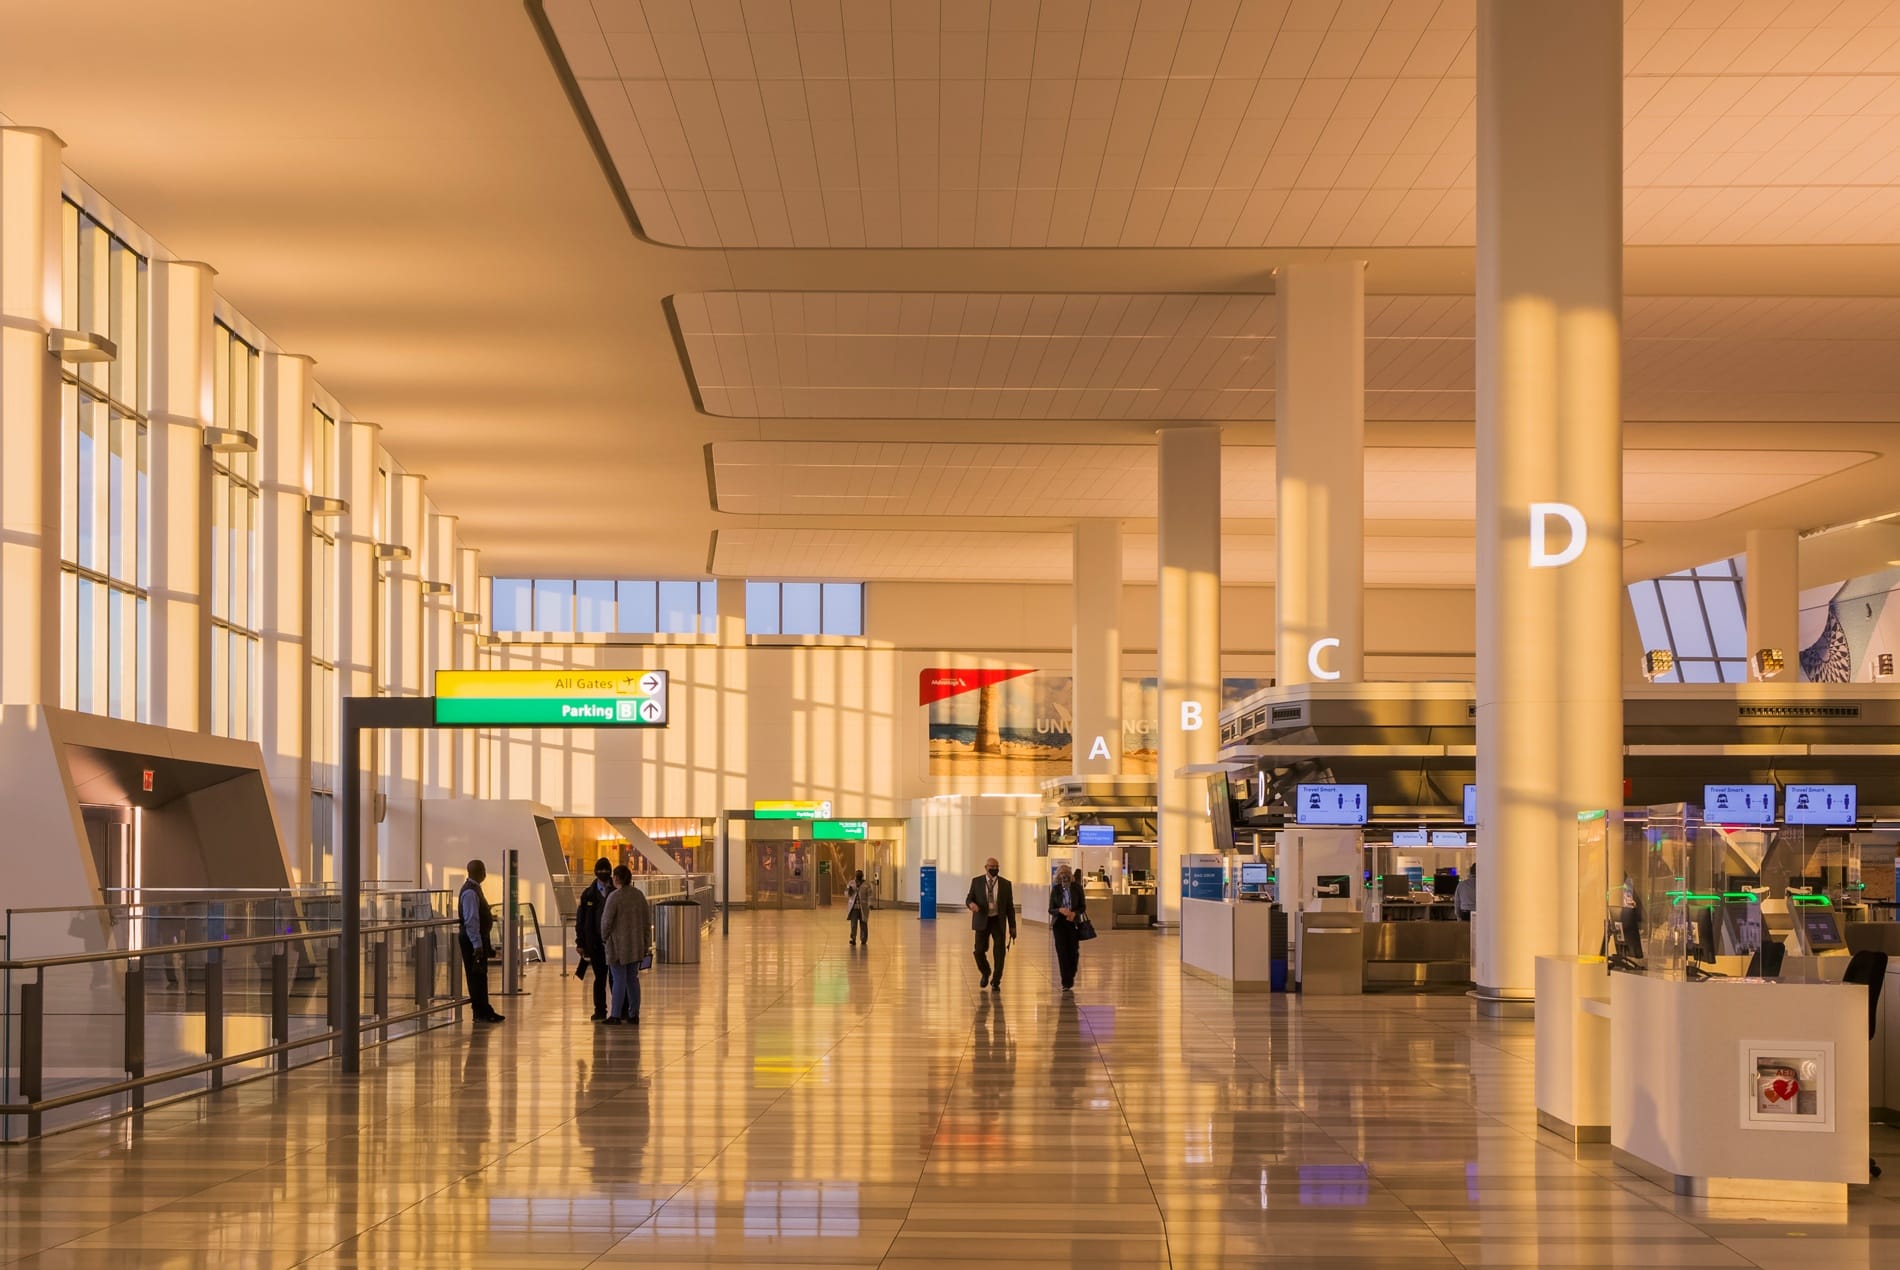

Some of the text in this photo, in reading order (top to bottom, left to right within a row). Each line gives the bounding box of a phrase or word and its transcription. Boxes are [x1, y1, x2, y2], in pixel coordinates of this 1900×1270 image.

[1528, 502, 1588, 569] D
[1307, 637, 1341, 680] C
[555, 678, 613, 689] All Gates
[561, 703, 632, 720] Parking B
[1180, 700, 1204, 731] B
[1087, 735, 1112, 760] A
